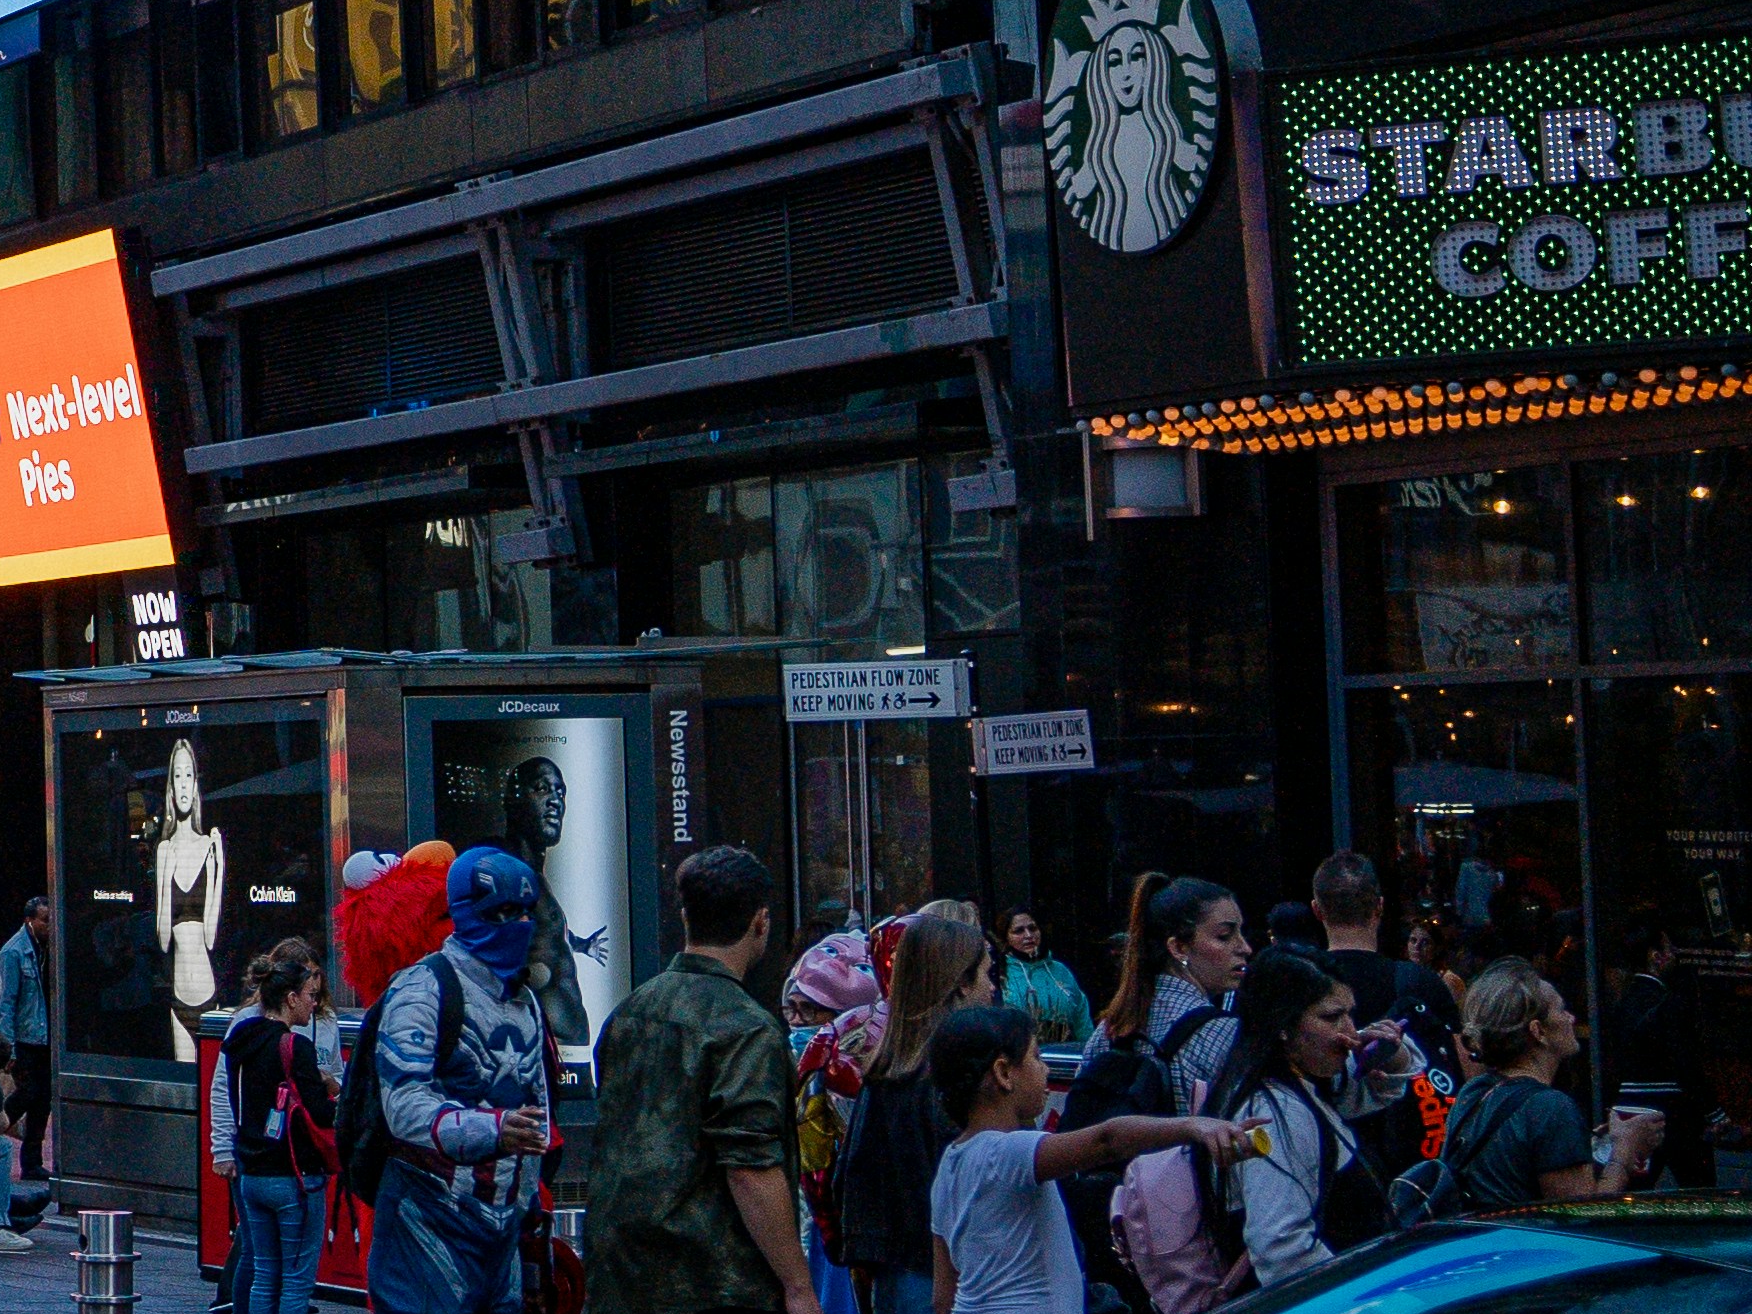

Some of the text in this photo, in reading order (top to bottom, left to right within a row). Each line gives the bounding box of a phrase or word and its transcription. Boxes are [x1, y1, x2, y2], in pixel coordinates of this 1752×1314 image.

[6, 363, 142, 440] Next-level
[18, 449, 76, 508] Pies
[131, 590, 177, 626] NOW
[138, 629, 185, 660] OPEN
[791, 668, 941, 689] PEDESTRIAN FLOW ZONE
[498, 701, 560, 714] JCDecaux
[792, 692, 875, 713] KEEP MOVING
[991, 719, 1085, 741] PEDESTRIAN FLOW ZONE
[995, 745, 1048, 766] KEEP MOVING
[669, 709, 692, 844] Newsstand
[249, 886, 296, 903] Calvin Klein
